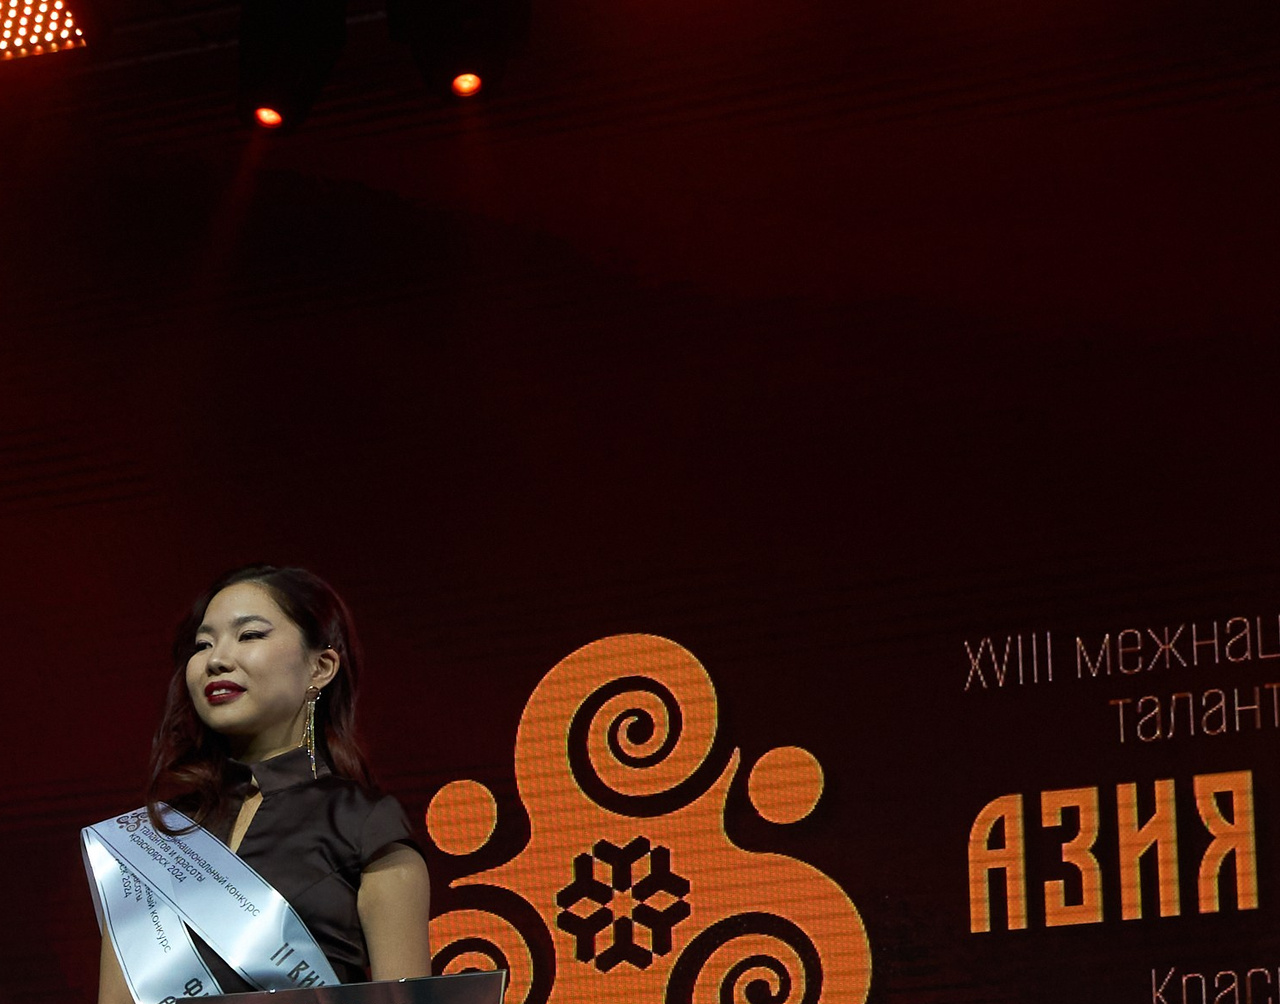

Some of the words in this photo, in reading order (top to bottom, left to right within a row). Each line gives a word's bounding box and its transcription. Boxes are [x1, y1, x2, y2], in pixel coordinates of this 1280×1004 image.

[964, 630, 1053, 692] XVIII
[129, 832, 170, 869] красноярск
[167, 863, 186, 884] 2024
[139, 825, 171, 856] талантов
[169, 848, 177, 858] и
[174, 852, 206, 883] красоты
[967, 769, 1259, 934] АЗИЯ
[121, 875, 131, 899] 2024
[224, 882, 261, 917] конкурс
[150, 909, 173, 954] конкурс
